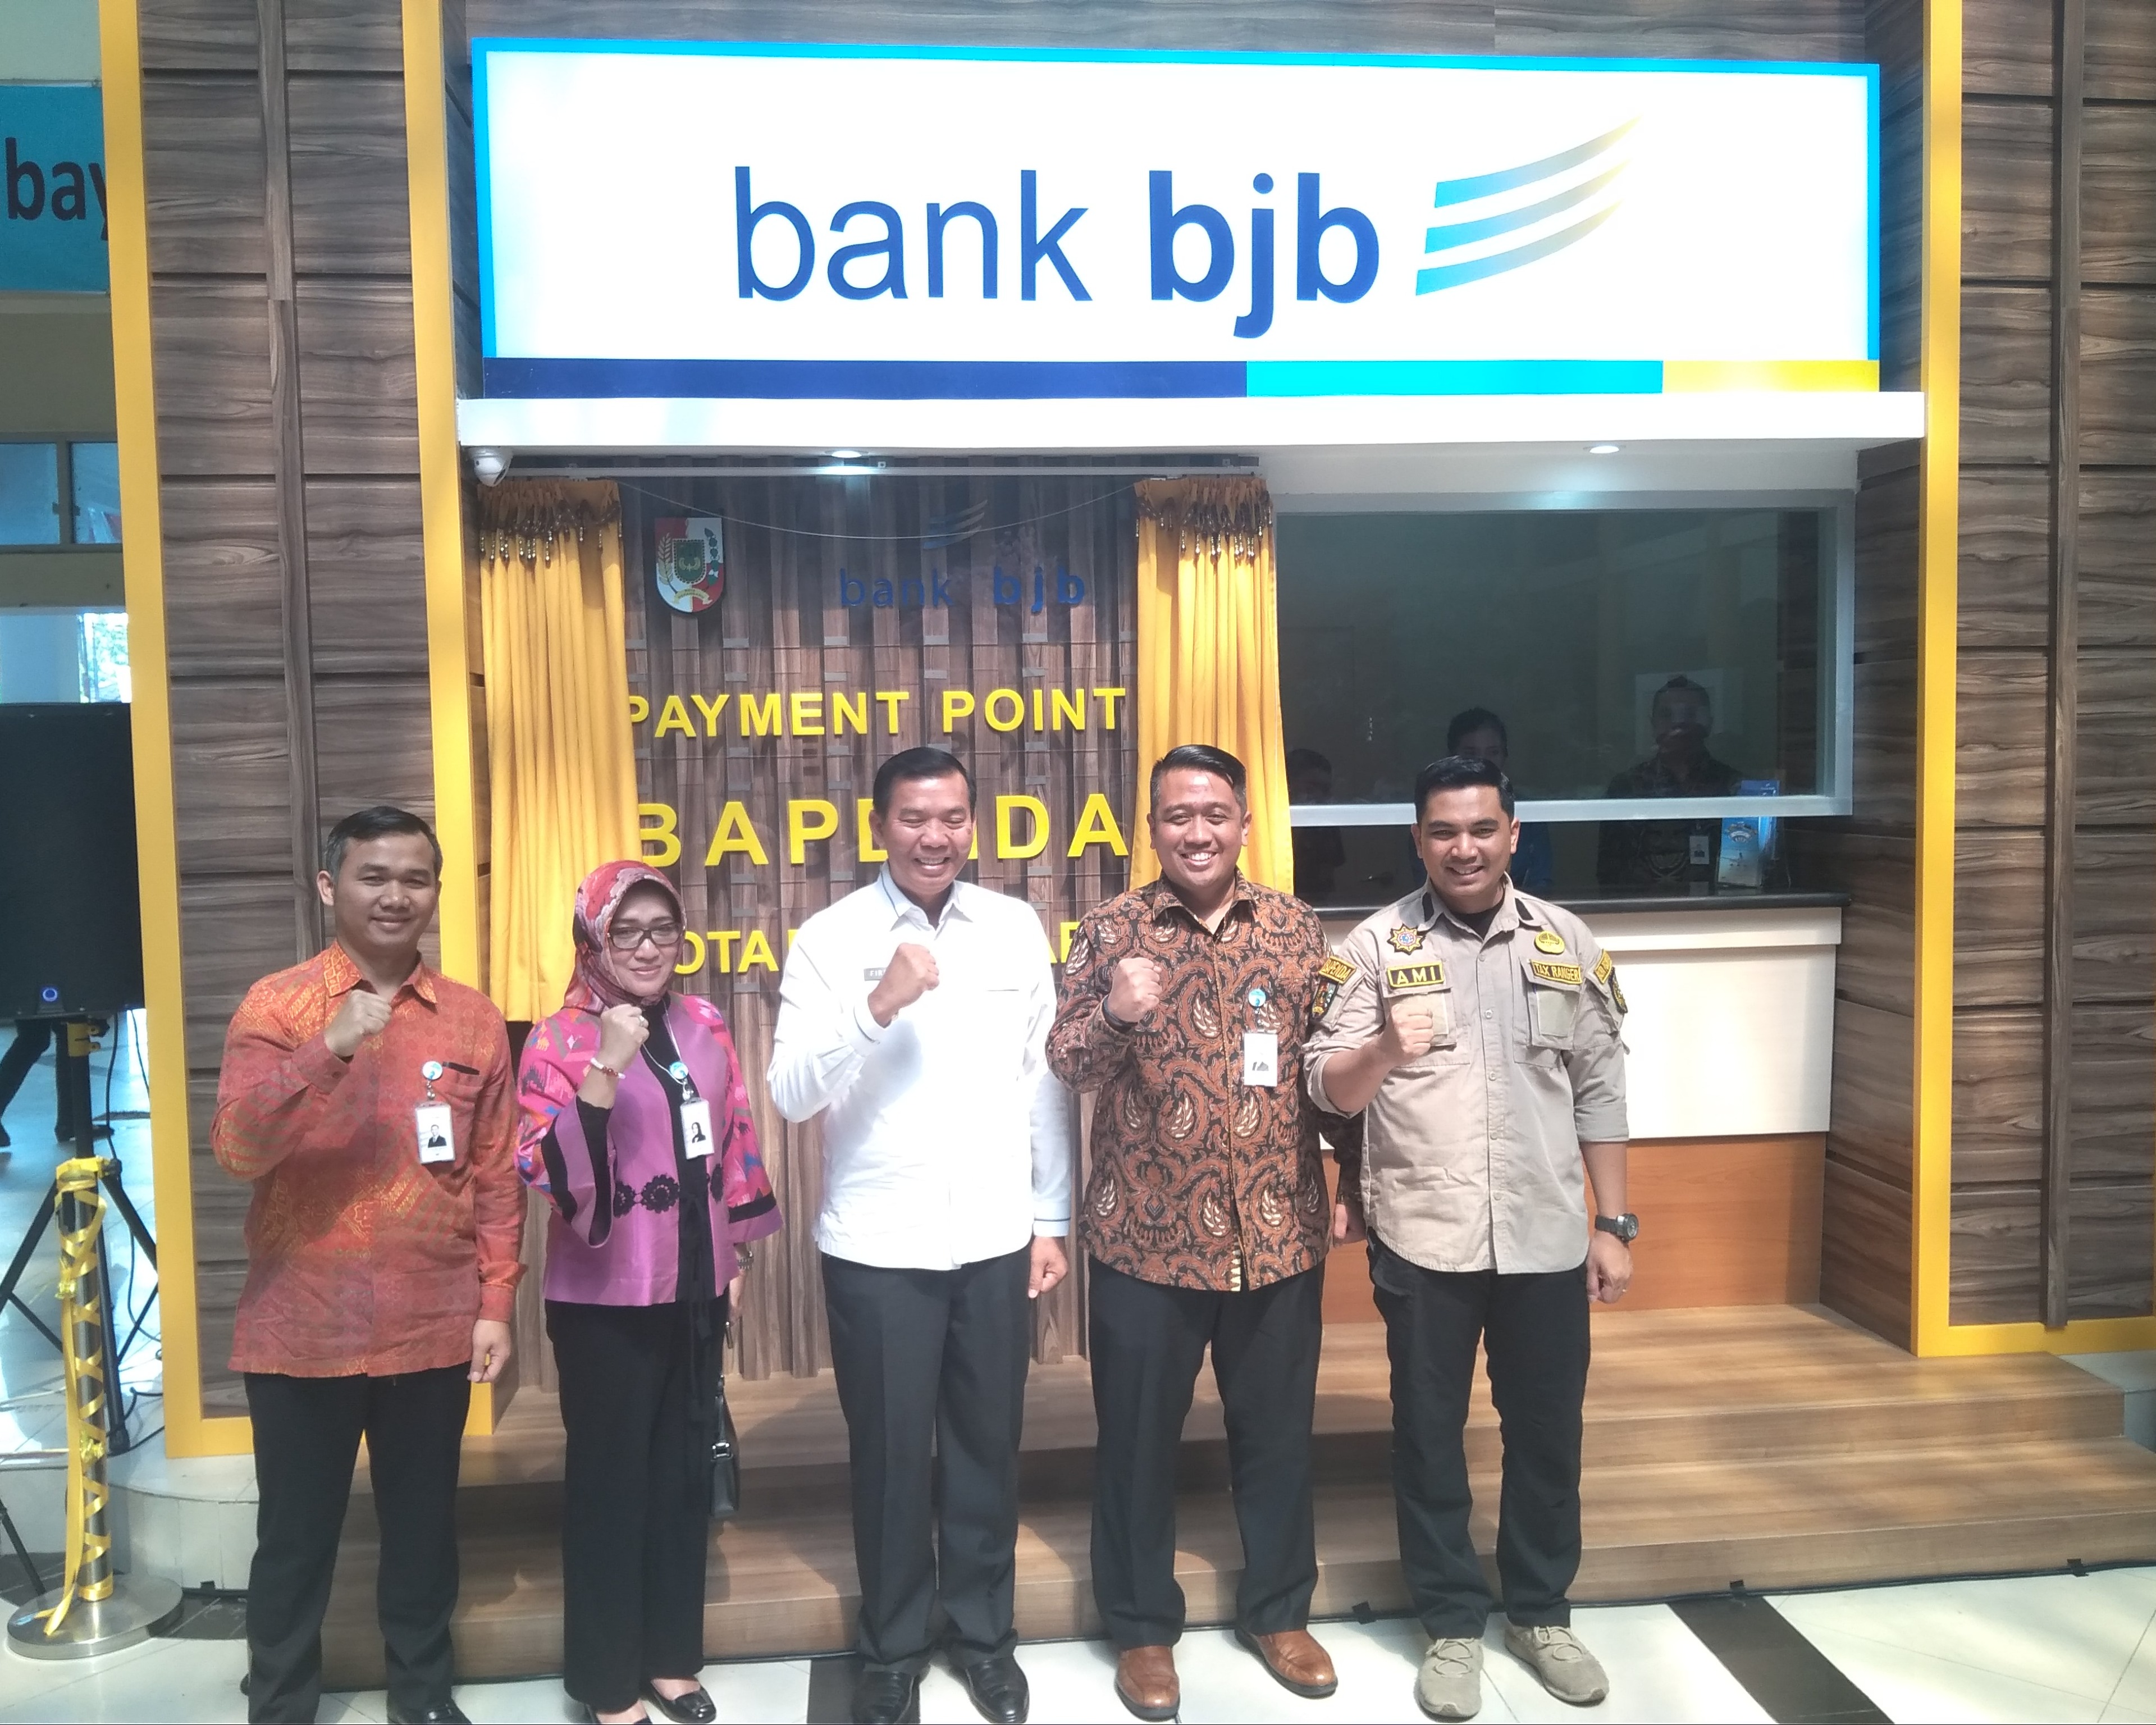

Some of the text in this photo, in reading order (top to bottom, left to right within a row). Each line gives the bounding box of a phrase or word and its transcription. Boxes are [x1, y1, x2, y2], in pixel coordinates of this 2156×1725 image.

[734, 166, 1380, 339] bank bjb
[840, 566, 1085, 614] bank bjb
[943, 687, 1126, 733] POINT
[638, 793, 1129, 867] BAPDA
[674, 930, 779, 974] OTA
[1397, 966, 1436, 984] AMI
[1533, 963, 1550, 976] TAX
[1551, 966, 1579, 981] RANGER
